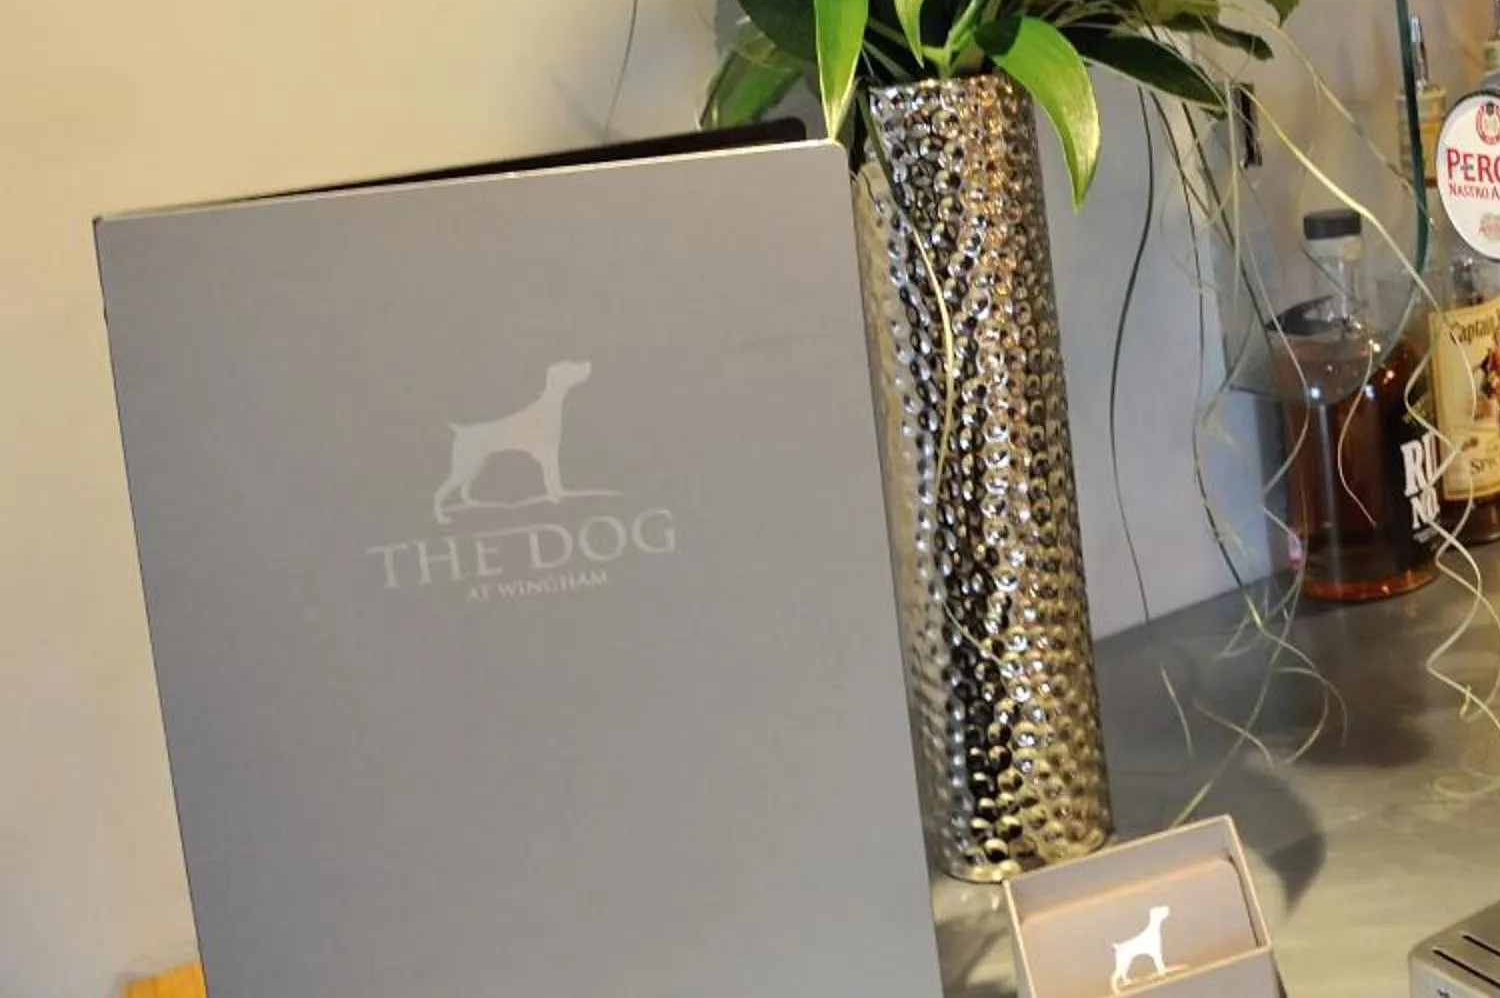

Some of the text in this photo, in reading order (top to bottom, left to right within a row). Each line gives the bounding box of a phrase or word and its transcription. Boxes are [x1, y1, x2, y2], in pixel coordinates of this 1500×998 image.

[366, 508, 677, 589] THE DOG
[466, 569, 610, 602] AT WINGHAM
